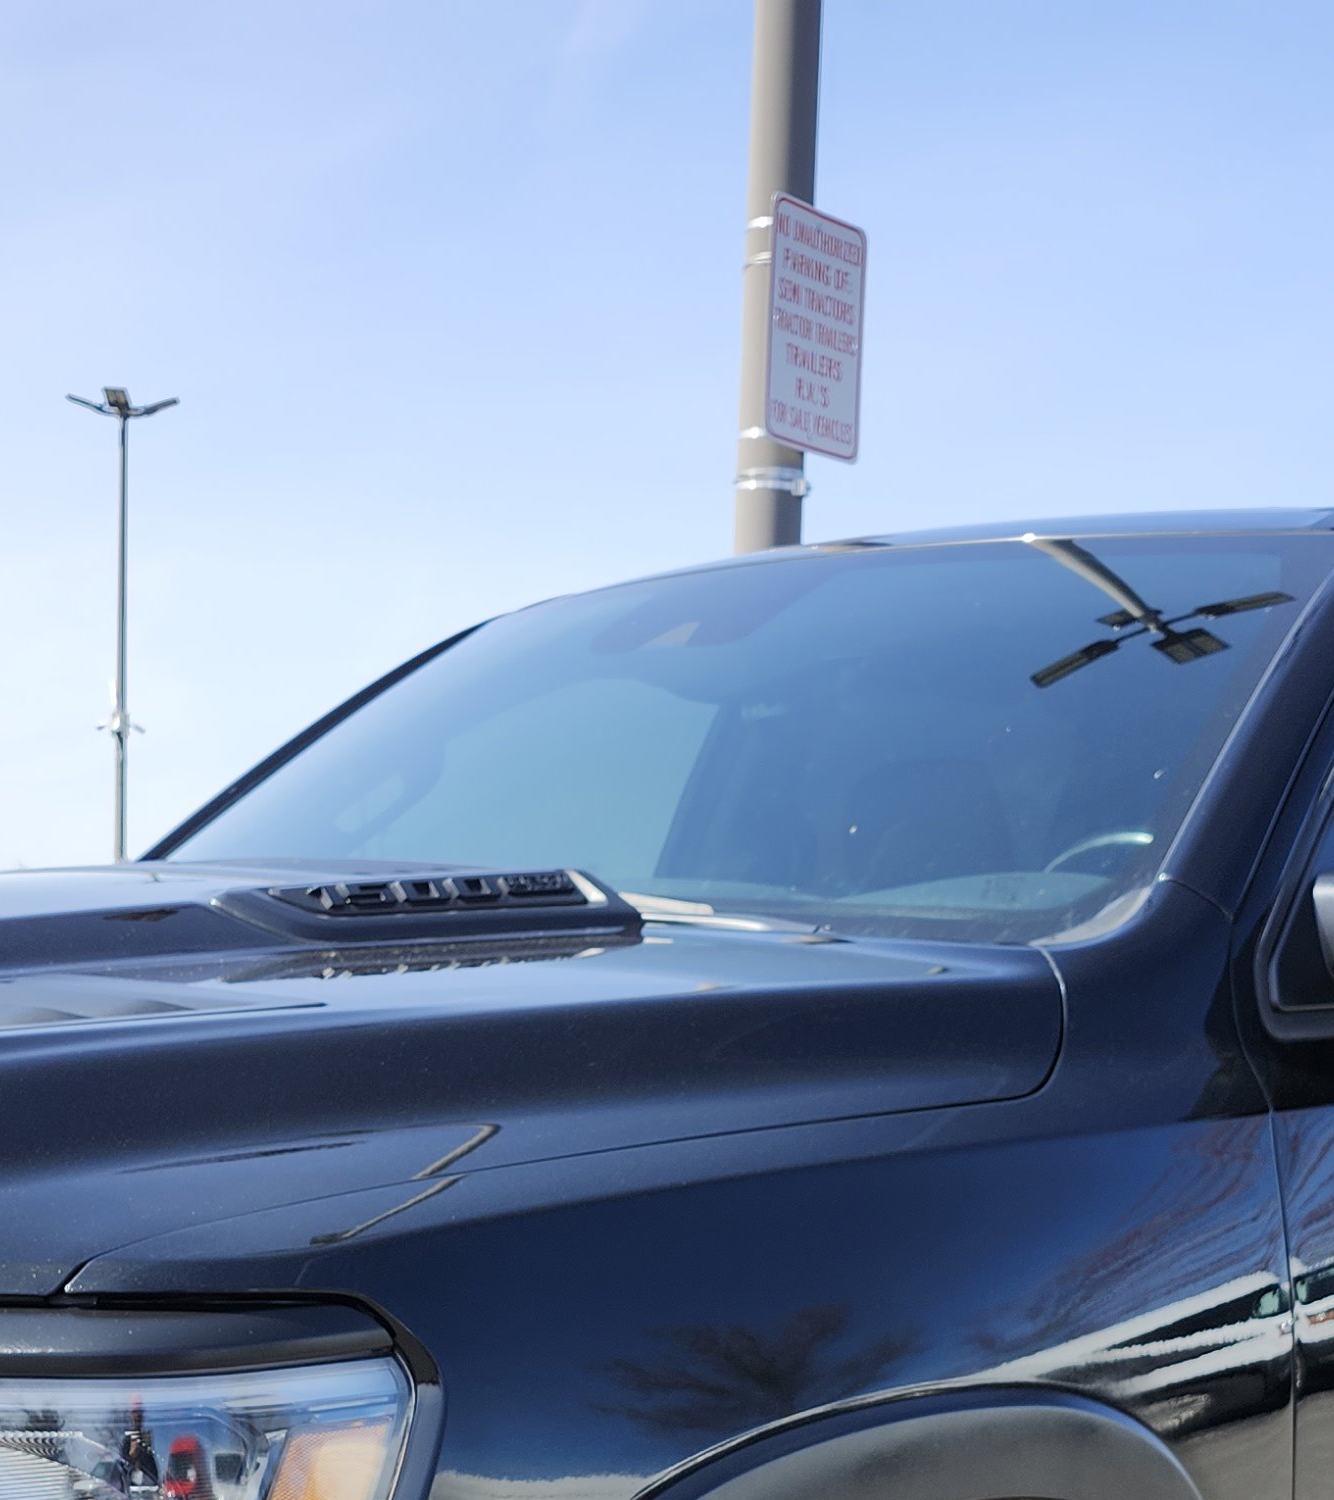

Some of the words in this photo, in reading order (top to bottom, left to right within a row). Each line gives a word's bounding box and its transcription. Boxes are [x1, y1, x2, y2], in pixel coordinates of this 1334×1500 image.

[776, 211, 790, 237] NO
[792, 218, 862, 266] UNAUTHORIZED
[781, 245, 832, 287] PARKING
[777, 275, 800, 305] SEMI
[802, 285, 856, 326] TRACTORS
[784, 341, 844, 383] TRAILERS
